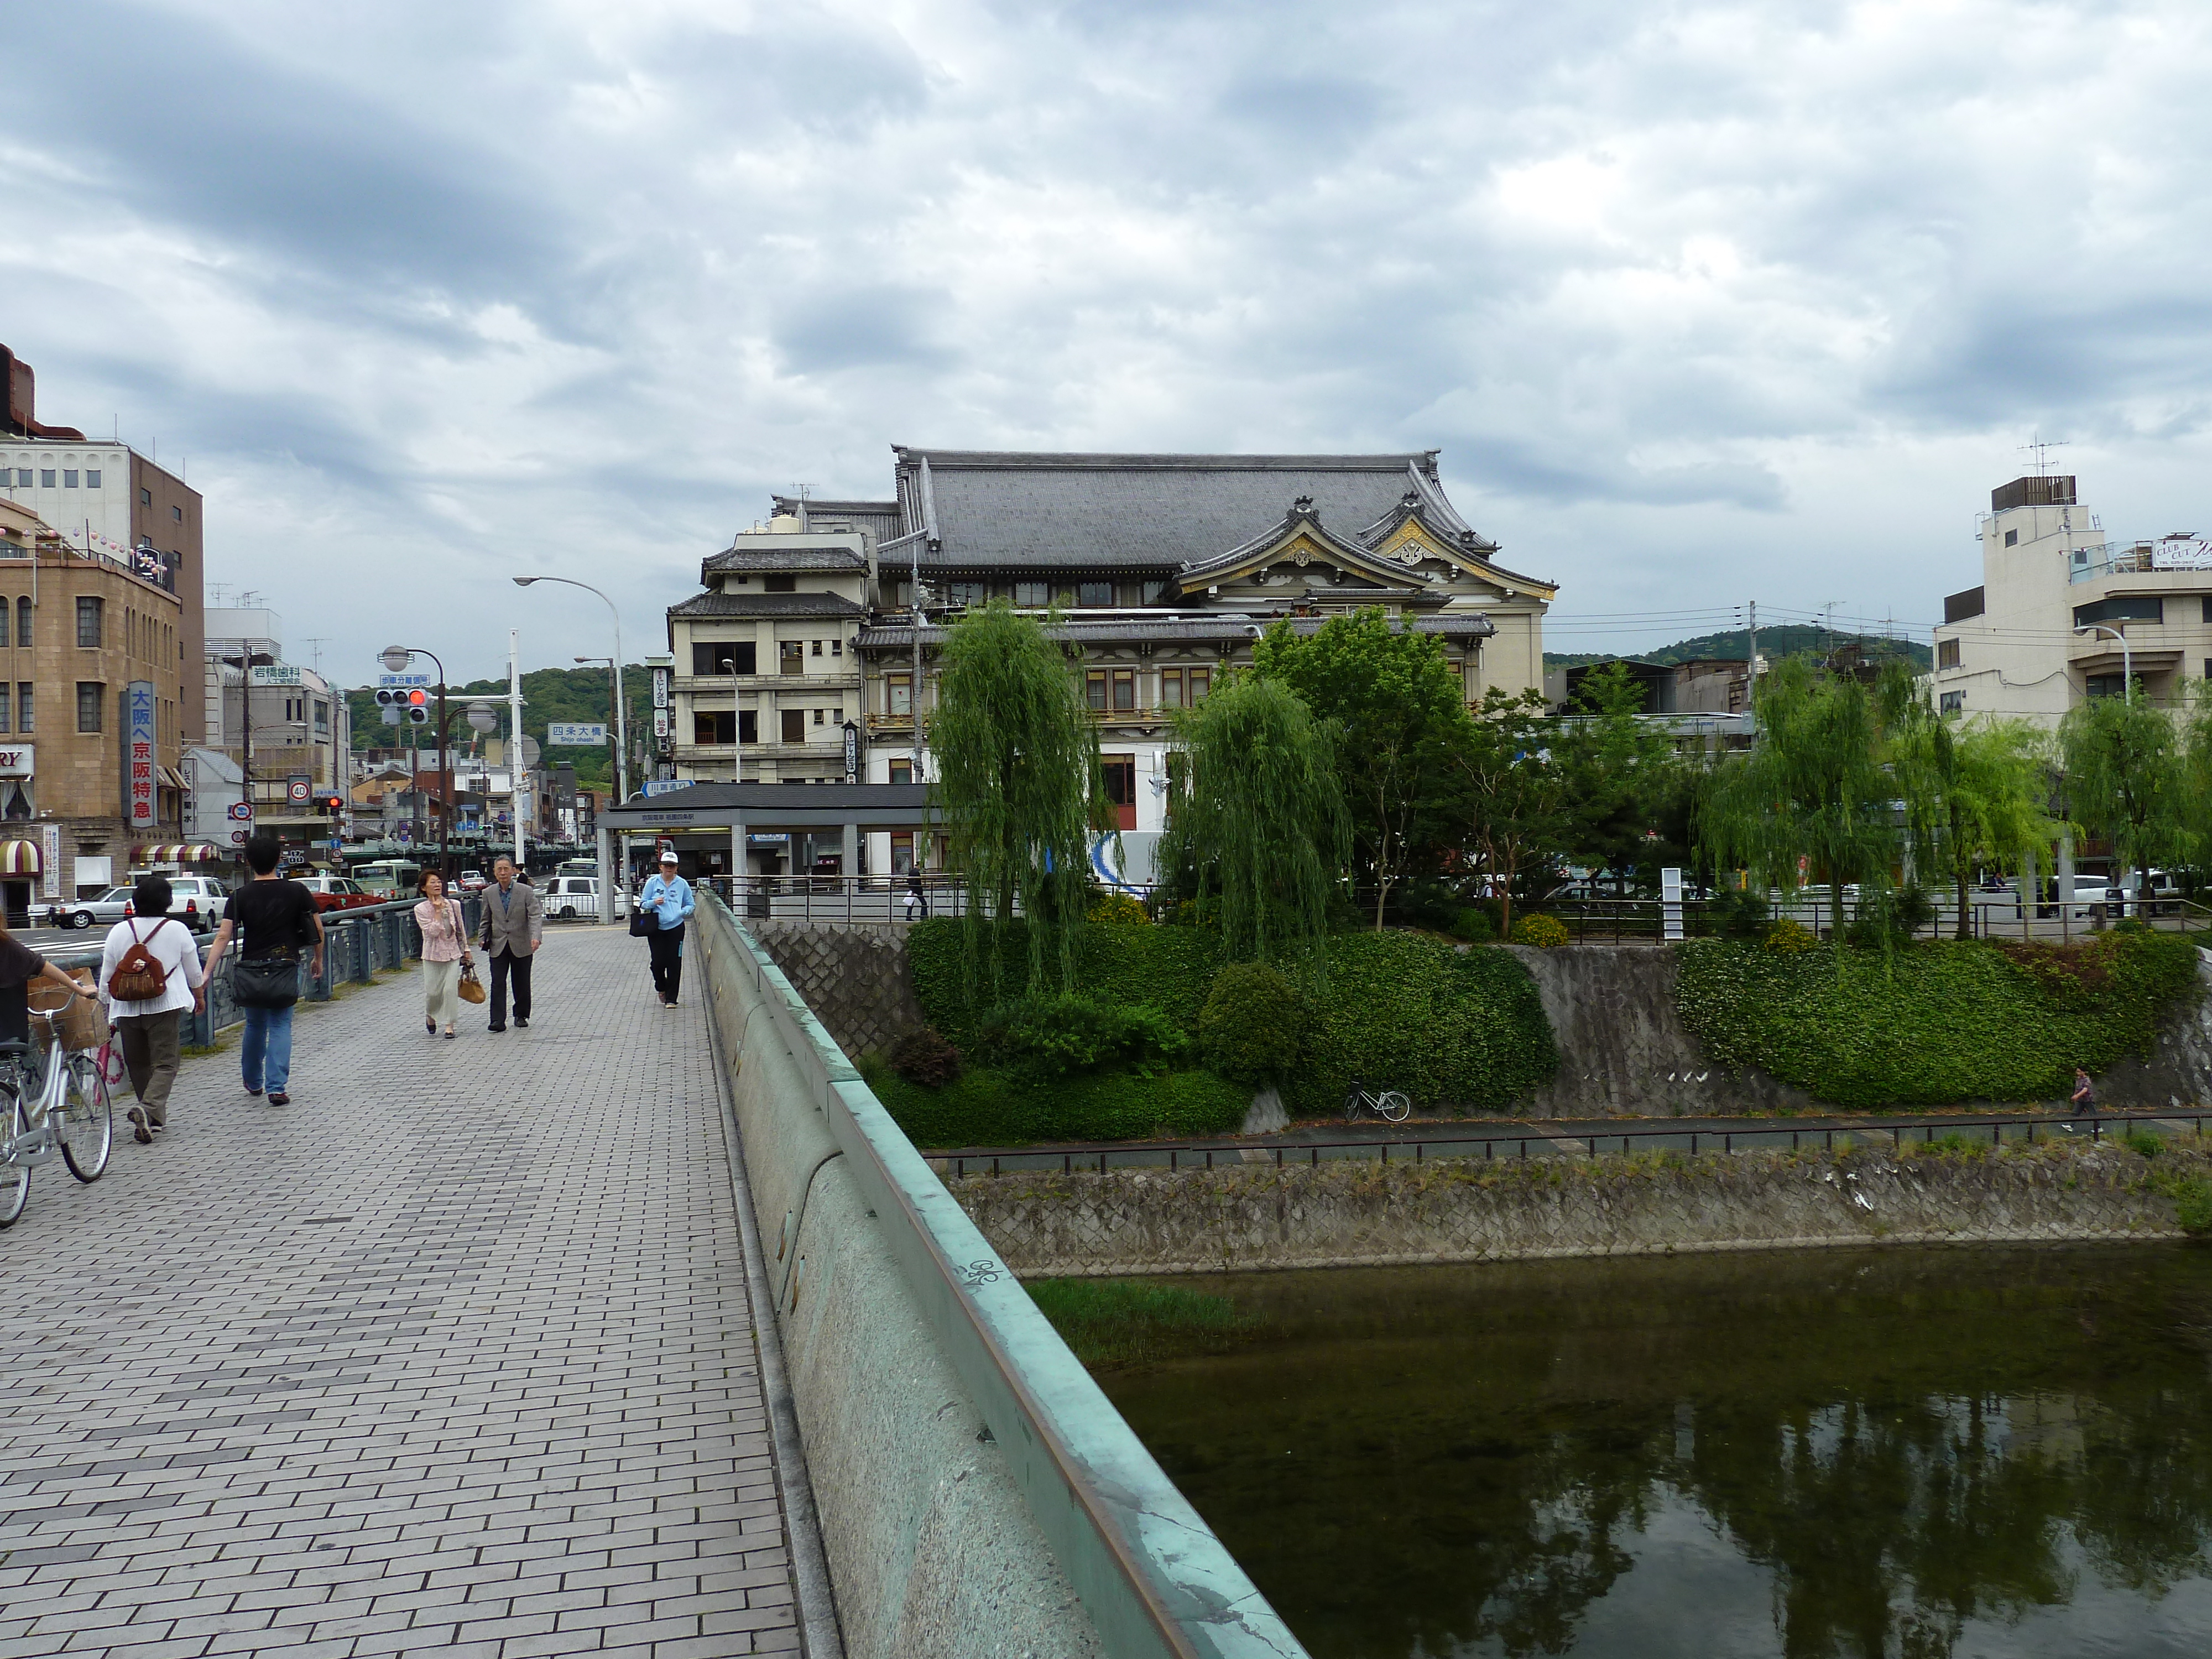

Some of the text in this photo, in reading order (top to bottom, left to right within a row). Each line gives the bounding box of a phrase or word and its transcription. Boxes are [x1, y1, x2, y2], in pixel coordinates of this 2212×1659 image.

[2157, 544, 2179, 556] CLUB
[2172, 549, 2190, 560] CUT
[254, 667, 300, 678] 岩橋歯科
[553, 726, 602, 736] 四条大橋
[132, 690, 151, 818] 大阪へ京阪特急
